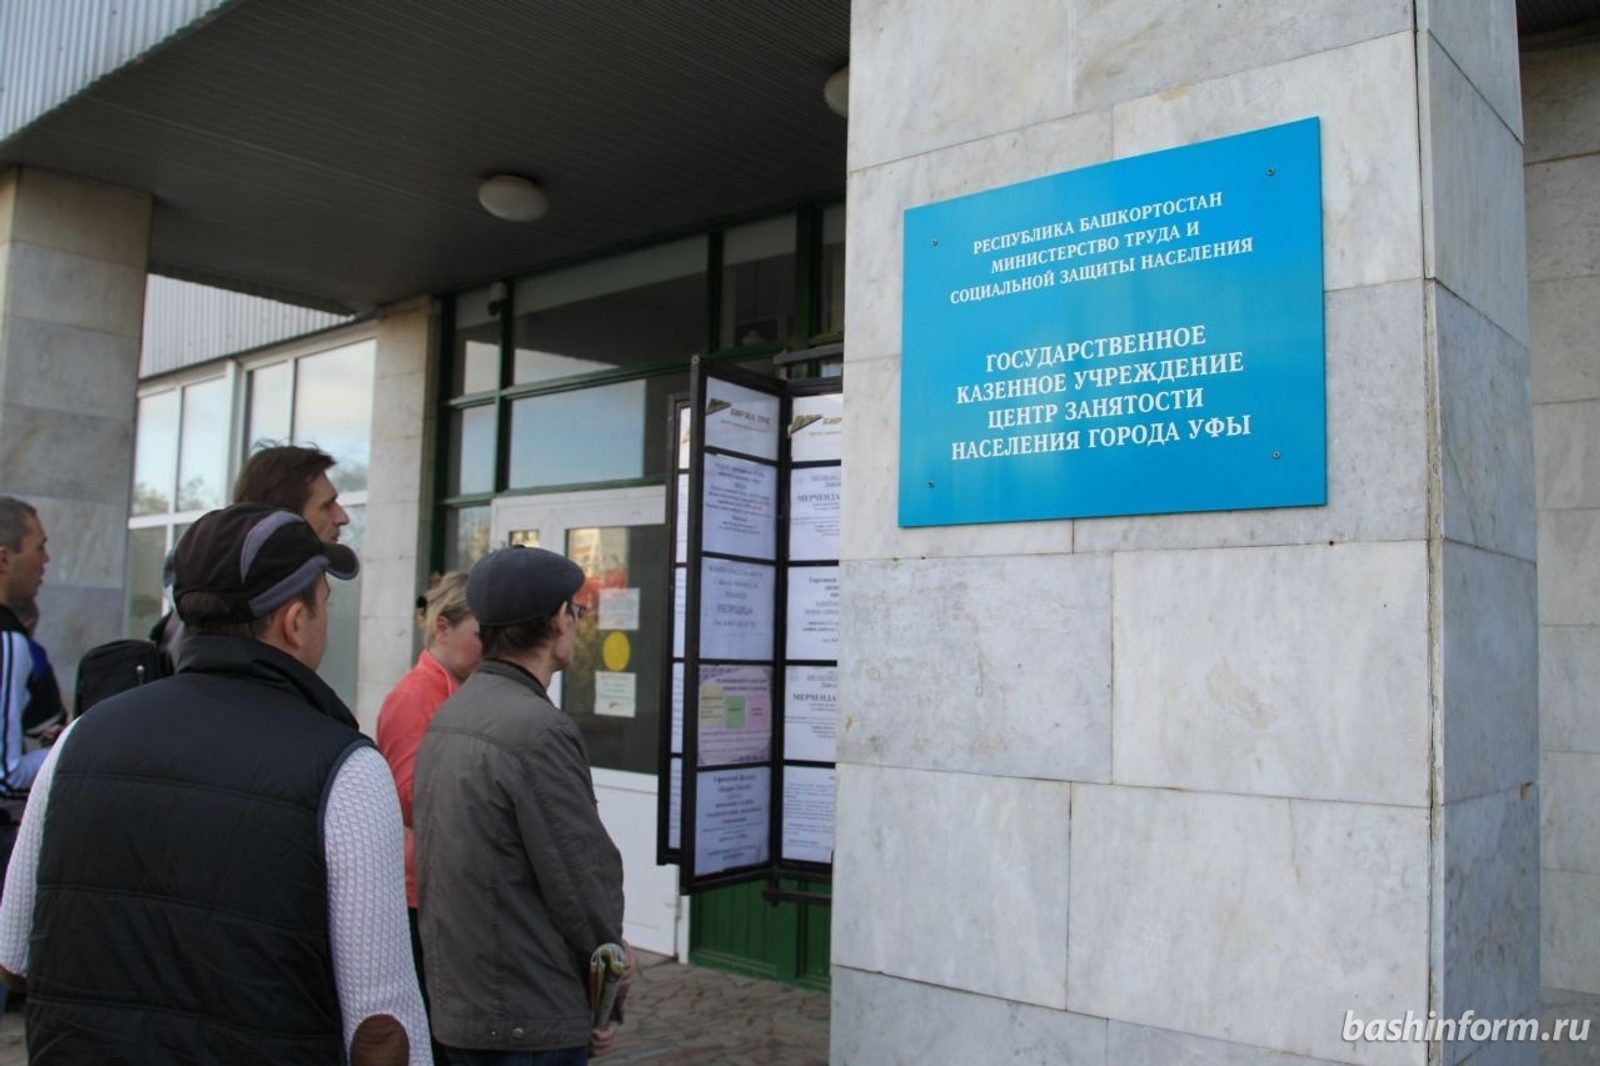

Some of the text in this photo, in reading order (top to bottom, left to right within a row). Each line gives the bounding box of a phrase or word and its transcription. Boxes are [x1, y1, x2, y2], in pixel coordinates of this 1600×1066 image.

[972, 191, 1223, 255] РЕСПУБЛИКА БАШКОРТОСТАН
[990, 221, 1200, 275] МИНИСТЕРСТВО ТРУДА И
[950, 237, 1254, 305] СОЦИАЛЬНОЙ ЗАЩИТЫ НАСЕЛЕНИЯ
[985, 324, 1207, 373] ГОСУДАРСТВЕННОЕ
[956, 350, 1245, 405] КАЗЕННОЕ УЧРЕЖДЕНИЕ
[987, 387, 1205, 430] ЦЕНТР ЗАНЯТОСТИ
[951, 413, 1252, 461] НАСЕЛЕНИЯ ГОРОДА УФЫ
